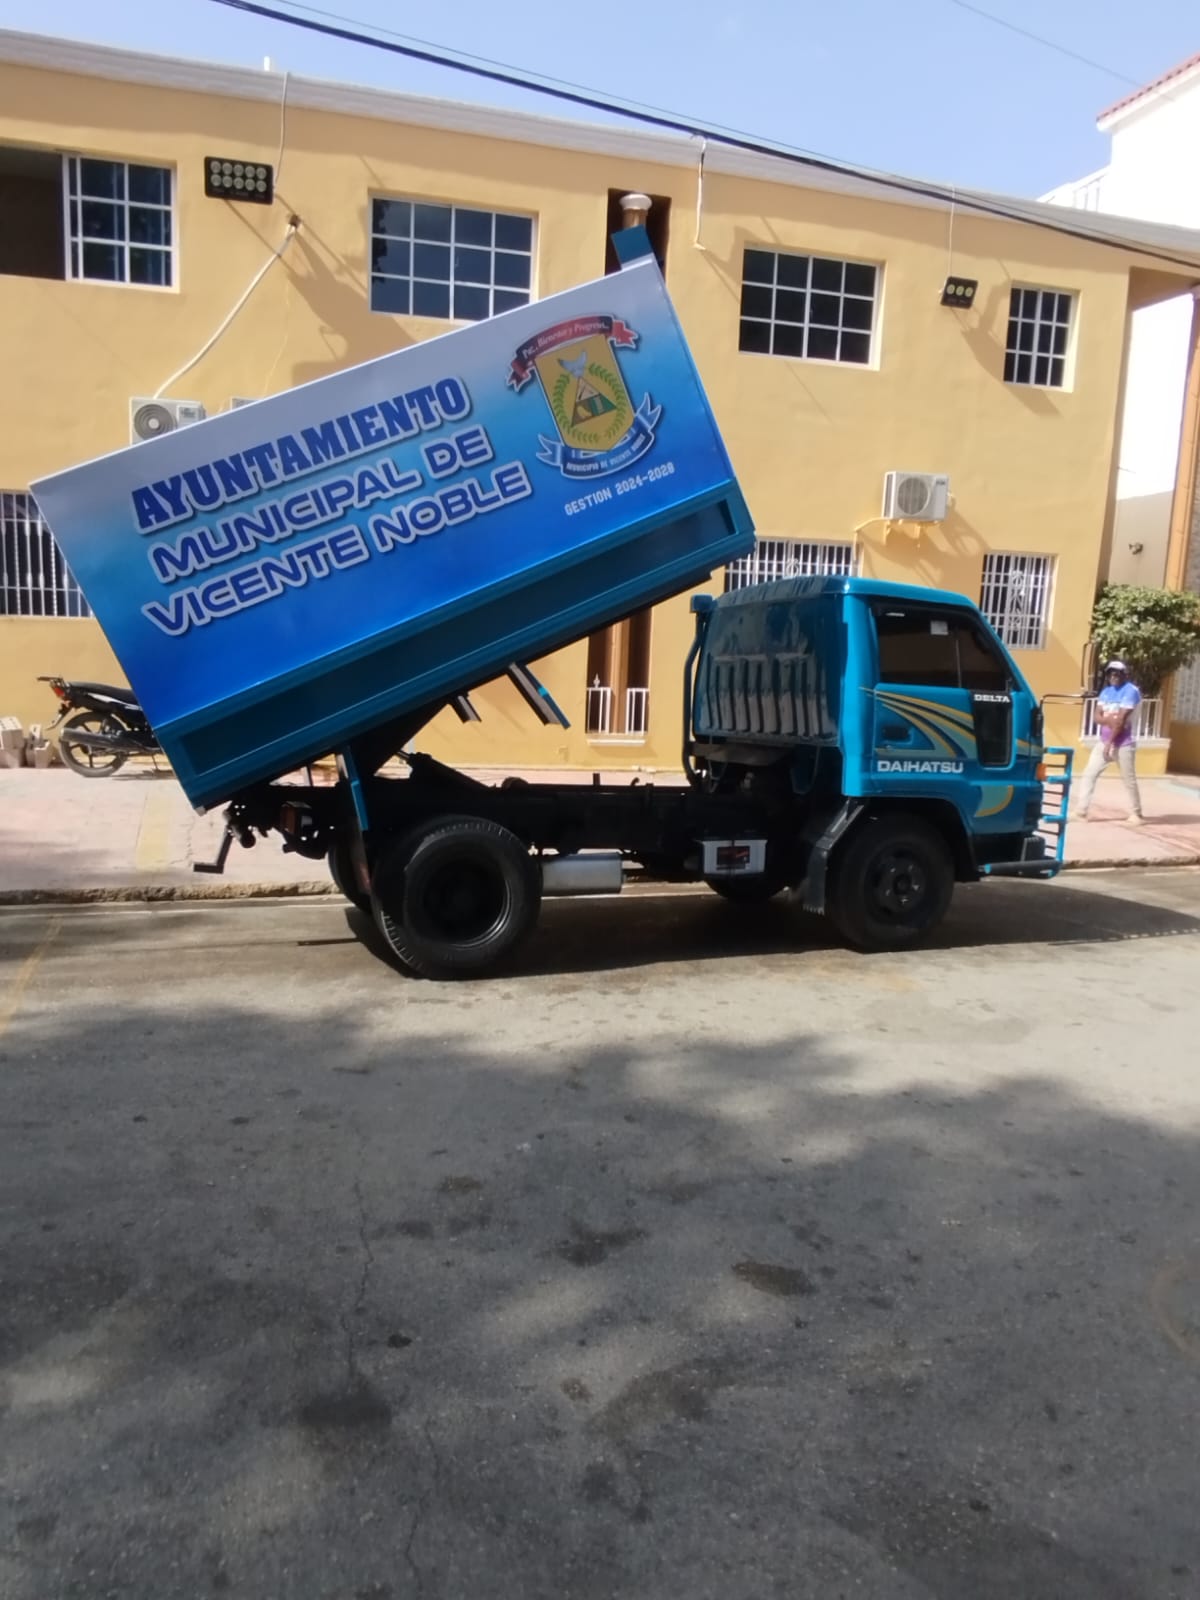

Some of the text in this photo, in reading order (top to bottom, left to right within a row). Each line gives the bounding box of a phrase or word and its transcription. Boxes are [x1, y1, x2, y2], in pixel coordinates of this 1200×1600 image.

[131, 377, 468, 531] AYUNTAMIENTO
[150, 426, 491, 581] MUNICIPAL DE
[564, 461, 676, 516] GESTION 2024-2028
[144, 463, 529, 634] VICENTE NOBLE
[973, 693, 1010, 703] DELTA
[877, 760, 964, 774] DAIHATSU
